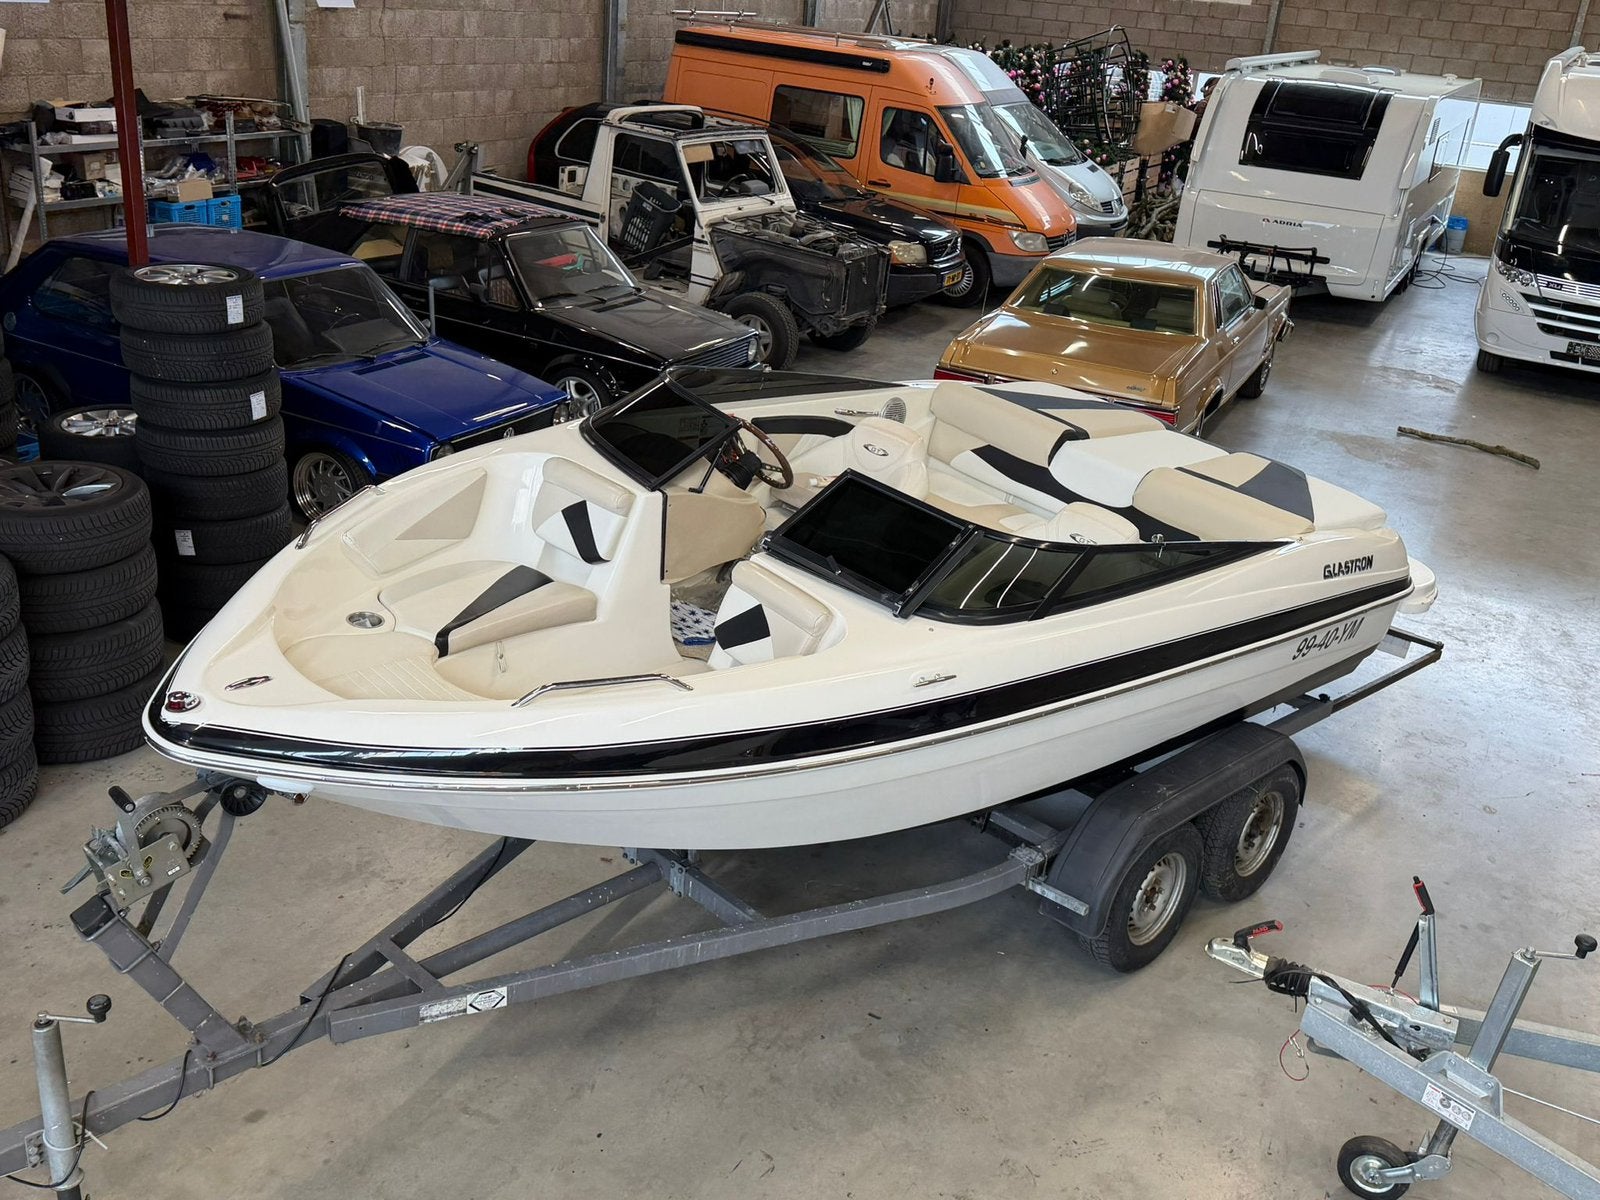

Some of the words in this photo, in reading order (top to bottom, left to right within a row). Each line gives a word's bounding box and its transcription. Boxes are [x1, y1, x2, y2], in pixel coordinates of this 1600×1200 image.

[1272, 219, 1303, 228] ADRIA
[1323, 554, 1374, 580] GLASTRON
[1292, 617, 1365, 660] 99-40-YM
